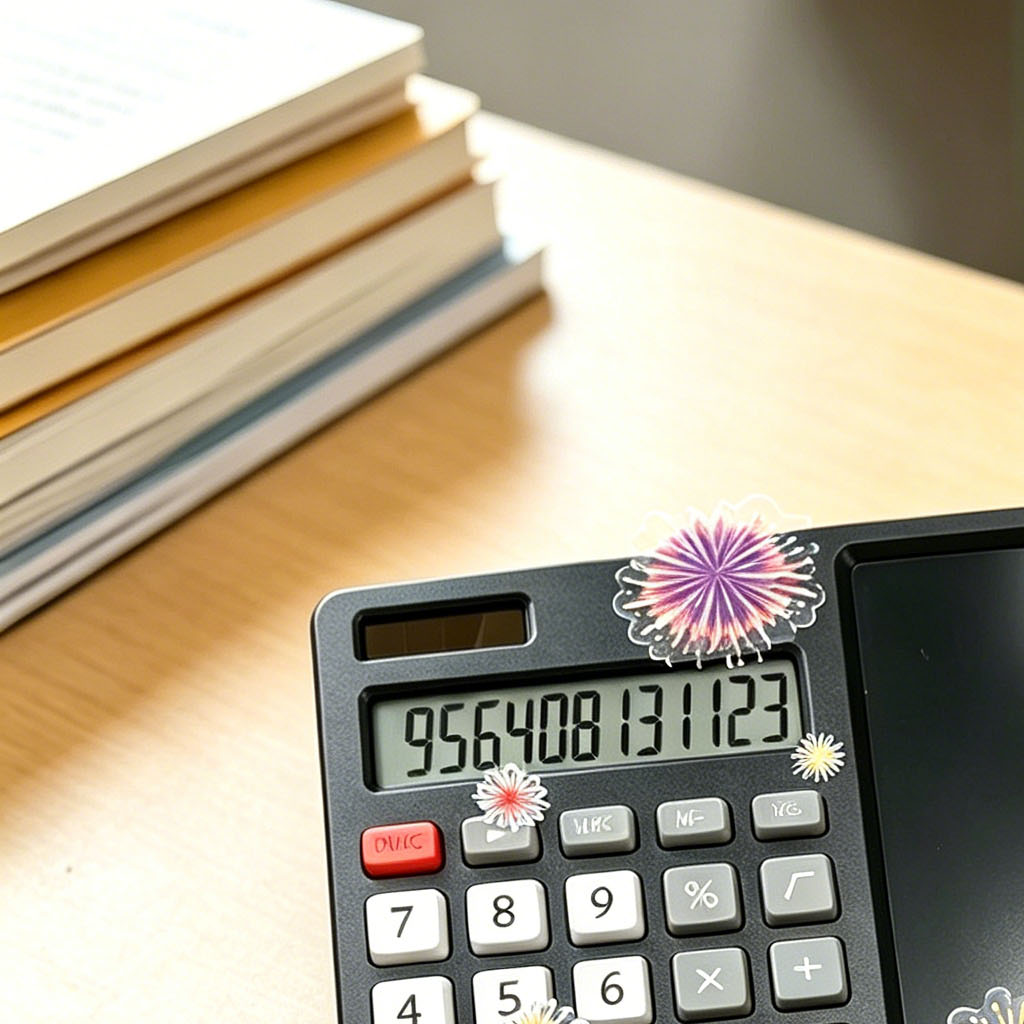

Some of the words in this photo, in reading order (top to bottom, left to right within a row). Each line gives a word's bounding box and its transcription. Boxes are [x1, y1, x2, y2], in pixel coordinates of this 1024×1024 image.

[405, 673, 788, 778] 956408131123
[492, 894, 516, 929] 8
[590, 886, 615, 920] 9
[390, 905, 415, 939] 7
[498, 980, 522, 1018] 5
[600, 970, 625, 1006] 6
